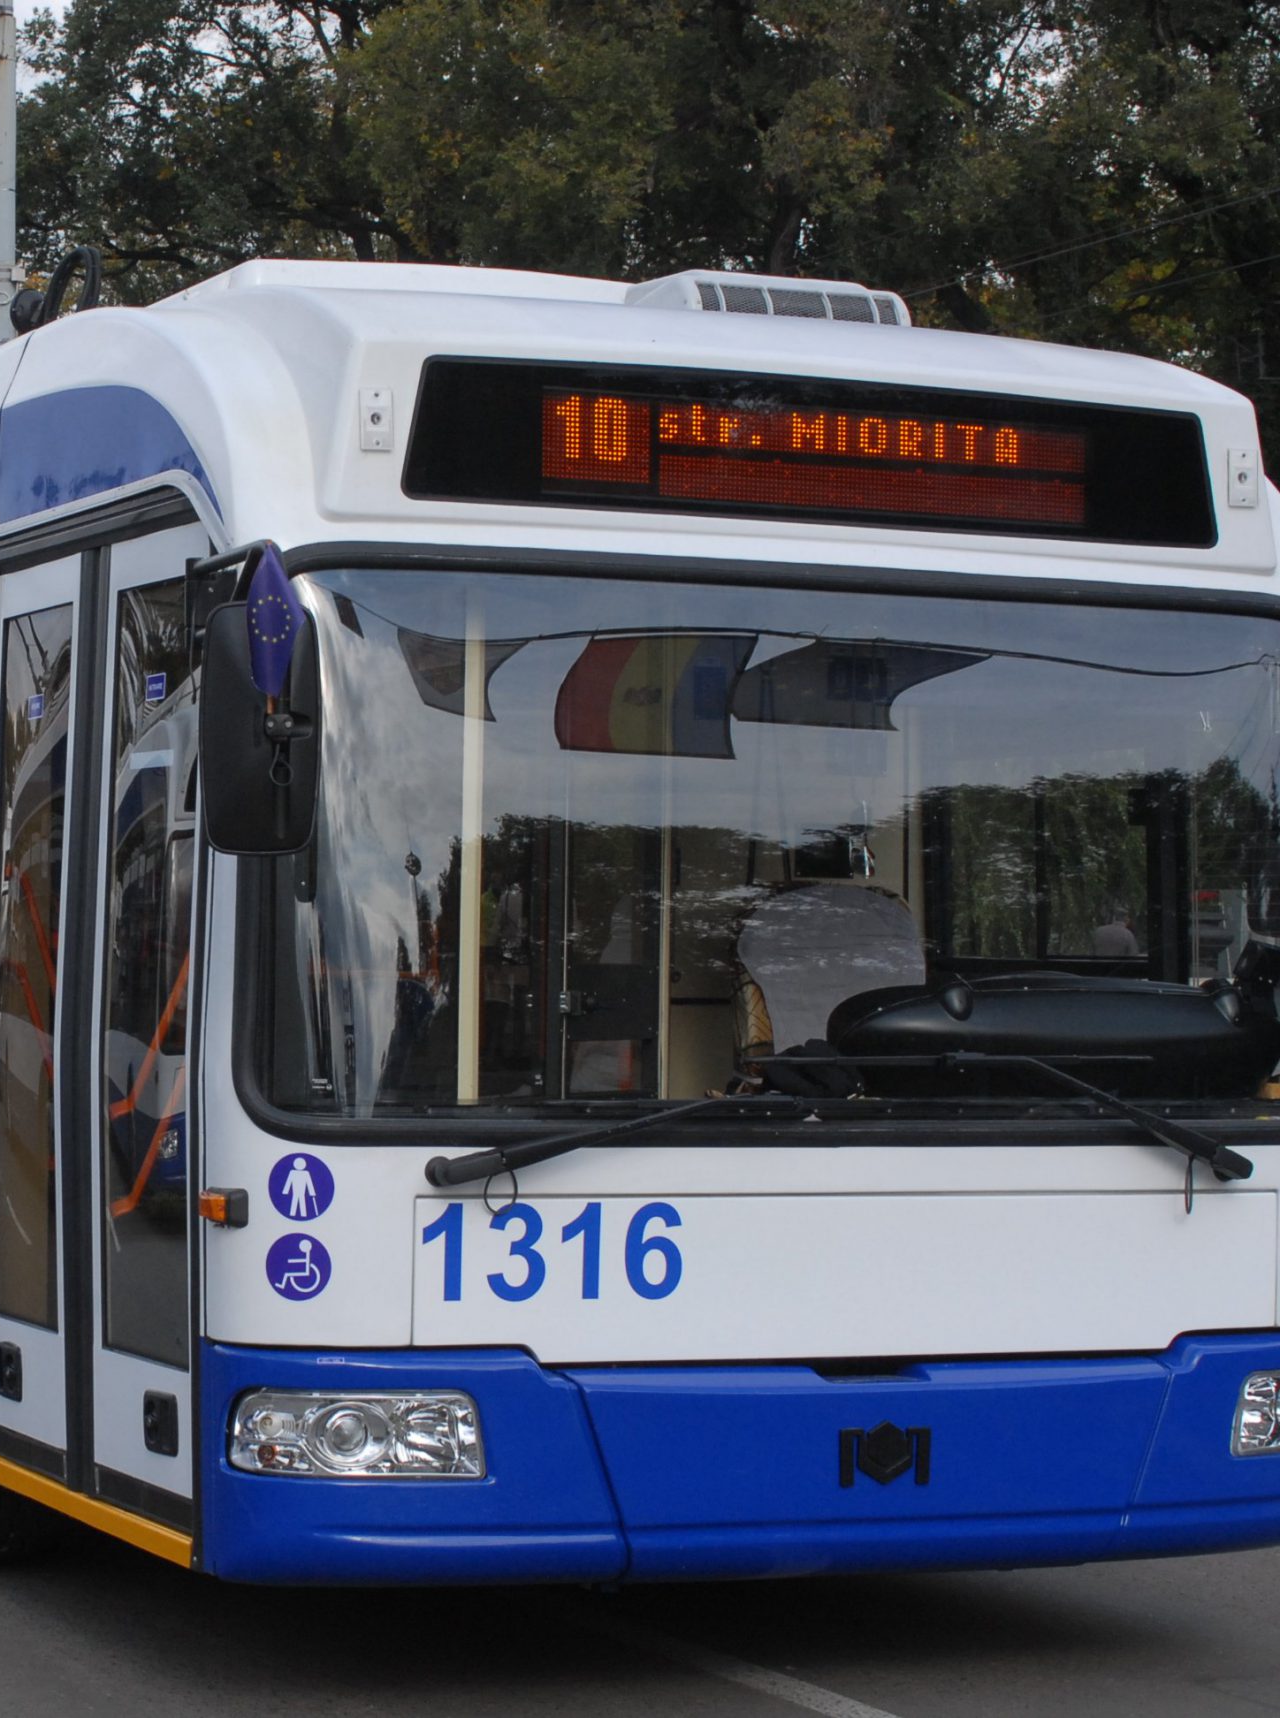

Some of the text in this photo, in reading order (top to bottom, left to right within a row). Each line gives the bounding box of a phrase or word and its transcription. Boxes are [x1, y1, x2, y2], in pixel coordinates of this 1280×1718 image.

[556, 396, 1019, 464] 10 str. MIORITA
[422, 1201, 683, 1302] 1316
